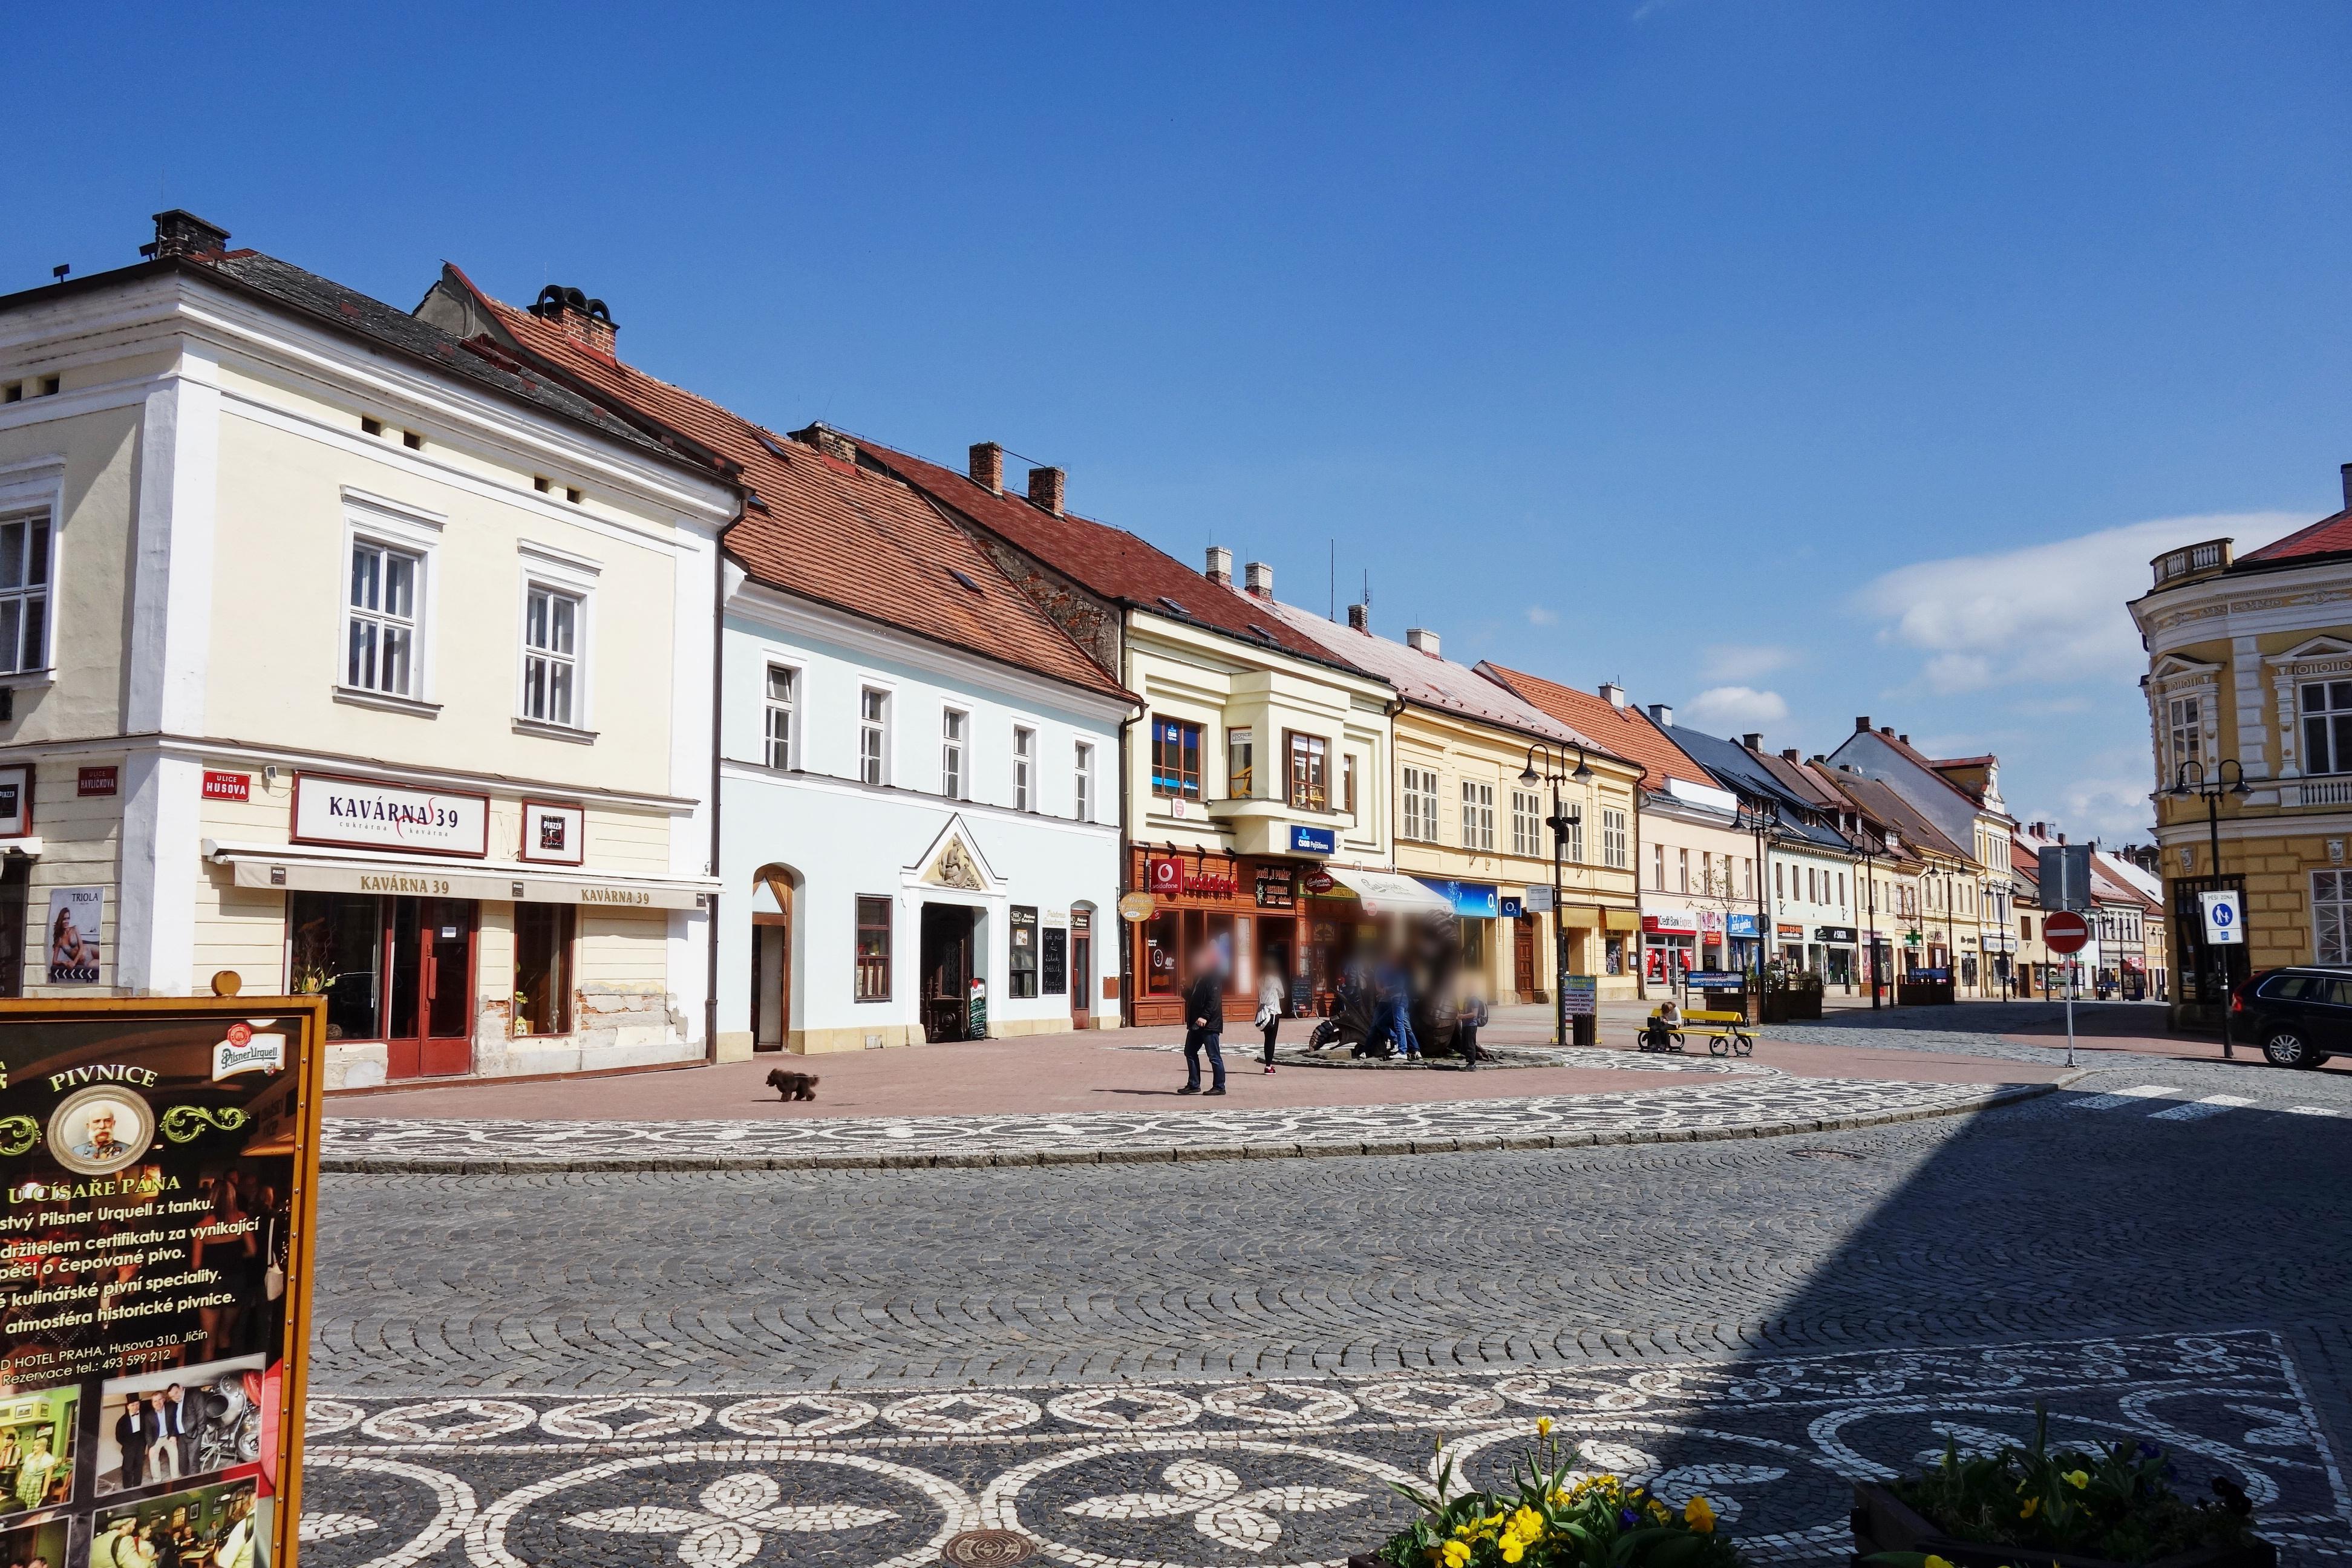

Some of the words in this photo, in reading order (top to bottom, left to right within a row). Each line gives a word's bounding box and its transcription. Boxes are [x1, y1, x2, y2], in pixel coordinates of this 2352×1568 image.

[206, 782, 246, 795] HUSOVA
[330, 796, 427, 825] KAVÁRNA
[436, 809, 459, 828] 39
[339, 821, 387, 831] cukrárna
[410, 828, 448, 837] kavárna
[543, 820, 562, 830] PIAZZA
[1298, 838, 1310, 847] ČSOB
[1310, 841, 1328, 850] Pojišťovna
[360, 875, 428, 893] KAVÁRNA
[433, 880, 449, 894] 39
[1186, 874, 1239, 892] vodafone
[71, 893, 98, 902] TRIOLA
[581, 888, 632, 903] KAVÁRNA
[637, 892, 649, 904] 39
[1670, 916, 1680, 927] Bank
[221, 1048, 251, 1070] Pilsner
[250, 1047, 278, 1062] Urquell
[48, 1064, 158, 1092] PIVNICE
[8, 1187, 27, 1204] U
[33, 1178, 116, 1201] CÍSAŘE
[121, 1175, 181, 1194] PÁNA
[0, 1212, 34, 1231] stvý
[39, 1210, 93, 1226] Pilsner
[98, 1203, 153, 1222] Urquell
[156, 1204, 165, 1215] z
[168, 1198, 214, 1214] tanku.
[1, 1240, 80, 1259] držitelem
[85, 1230, 164, 1250] certifikatu
[168, 1229, 186, 1241] za
[190, 1216, 260, 1240] vynikající
[0, 1261, 38, 1282] péči
[42, 1264, 53, 1275] o
[58, 1249, 144, 1273] čepované
[148, 1247, 186, 1265] pivo.
[11, 1282, 99, 1307] kulinářské
[103, 1276, 143, 1298] pivní
[146, 1269, 222, 1292] speciality.
[5, 1311, 93, 1334] atmosféra
[97, 1298, 174, 1322] historické
[177, 1293, 235, 1313] pivnice.
[15, 1353, 55, 1368] HOTEL
[59, 1346, 105, 1362] PRAHA,
[109, 1339, 153, 1354] Husova
[157, 1334, 180, 1347] 310,
[183, 1330, 208, 1342] Jičín
[2, 1367, 72, 1385] Rezervace
[76, 1362, 99, 1374] tel.:
[102, 1357, 123, 1370] 493
[126, 1353, 147, 1366] 599
[149, 1350, 171, 1362] 212
